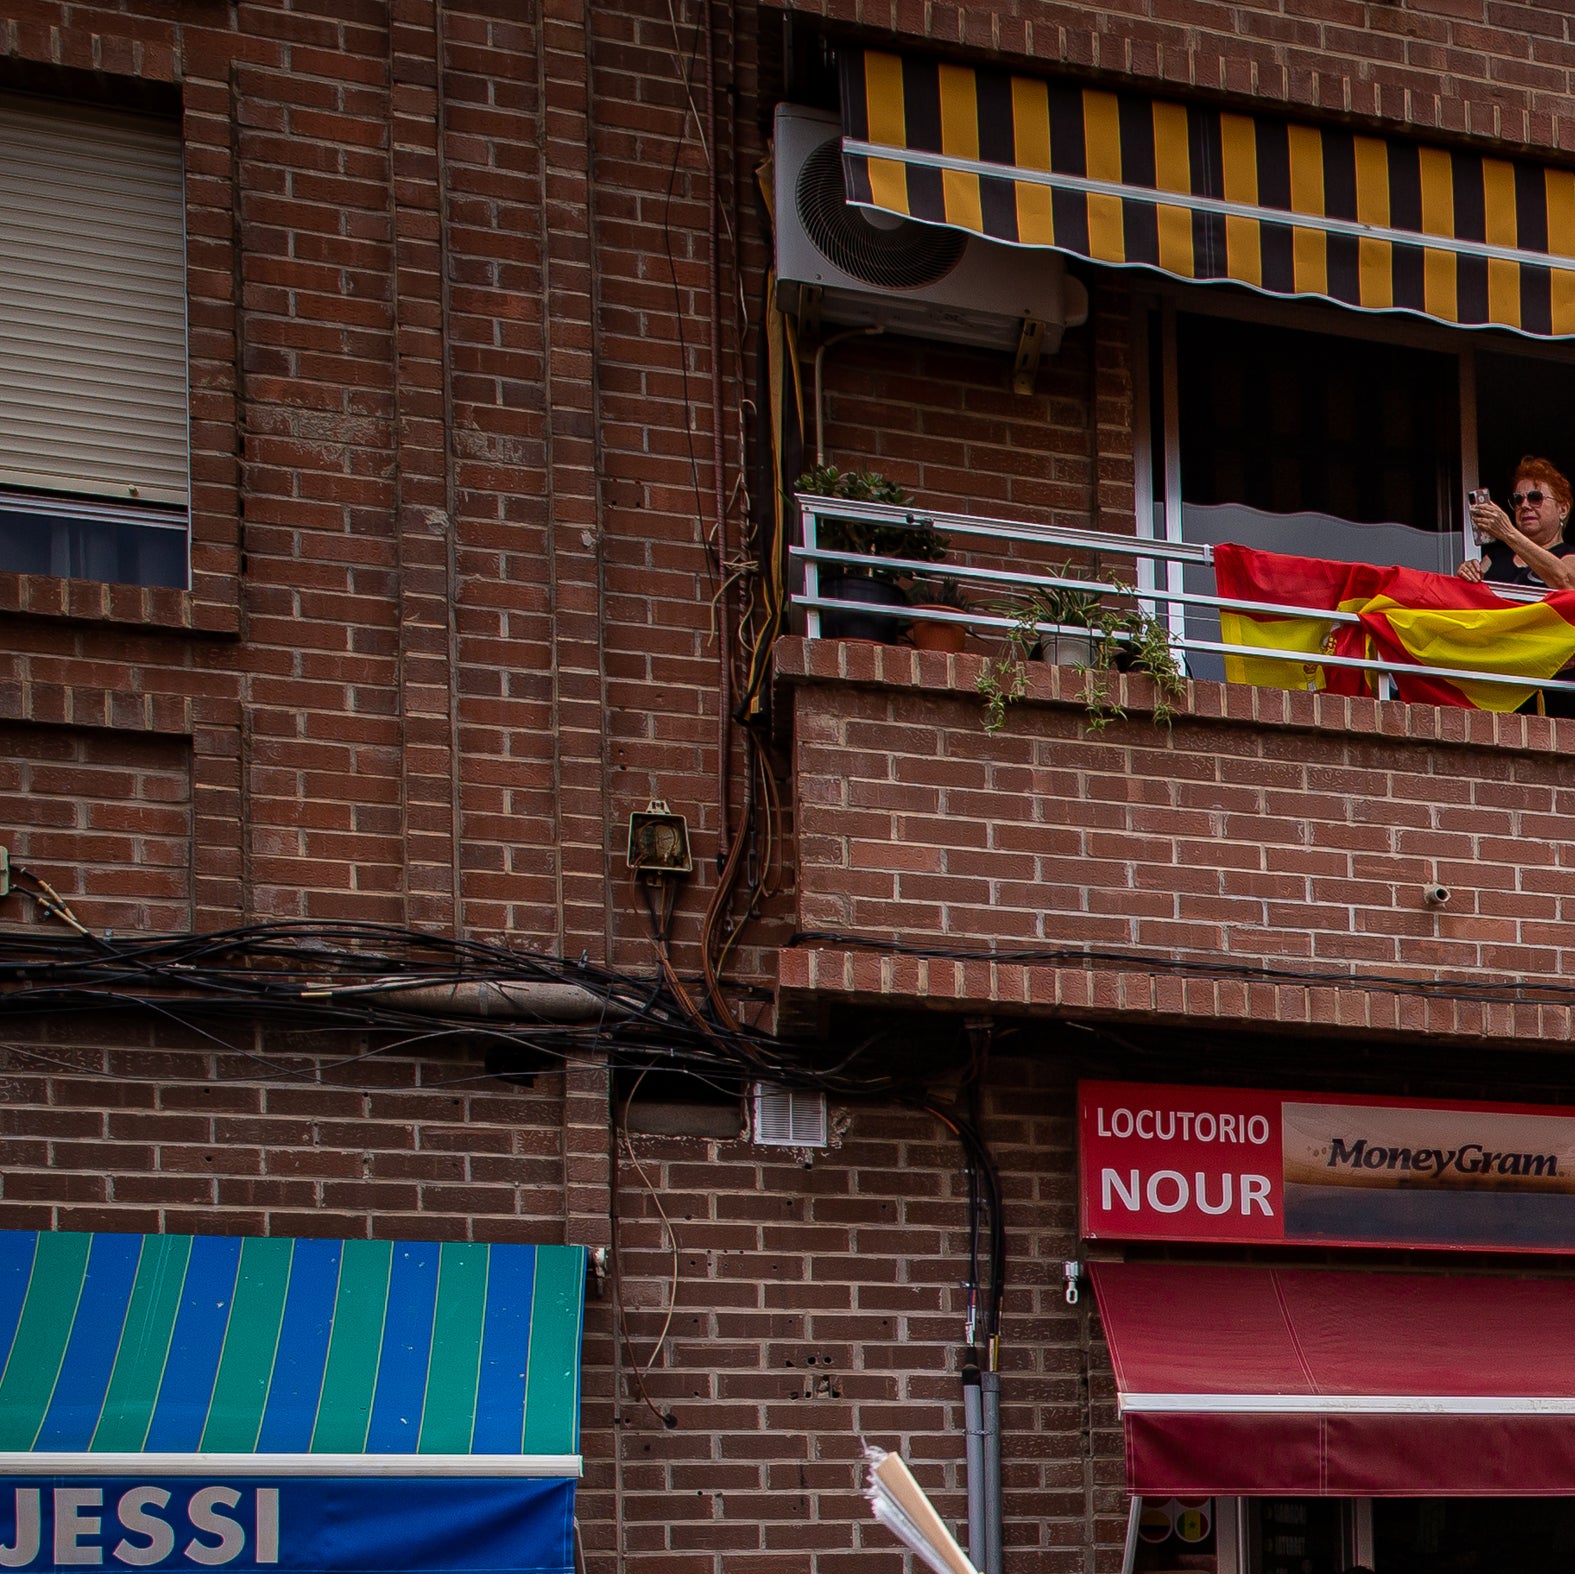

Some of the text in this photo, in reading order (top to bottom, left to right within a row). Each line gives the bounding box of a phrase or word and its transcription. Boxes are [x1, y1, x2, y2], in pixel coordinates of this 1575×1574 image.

[1096, 1107, 1270, 1145] LOCUTORIO
[1327, 1137, 1558, 1180] MoneyGram
[1100, 1168, 1274, 1217] NOUR
